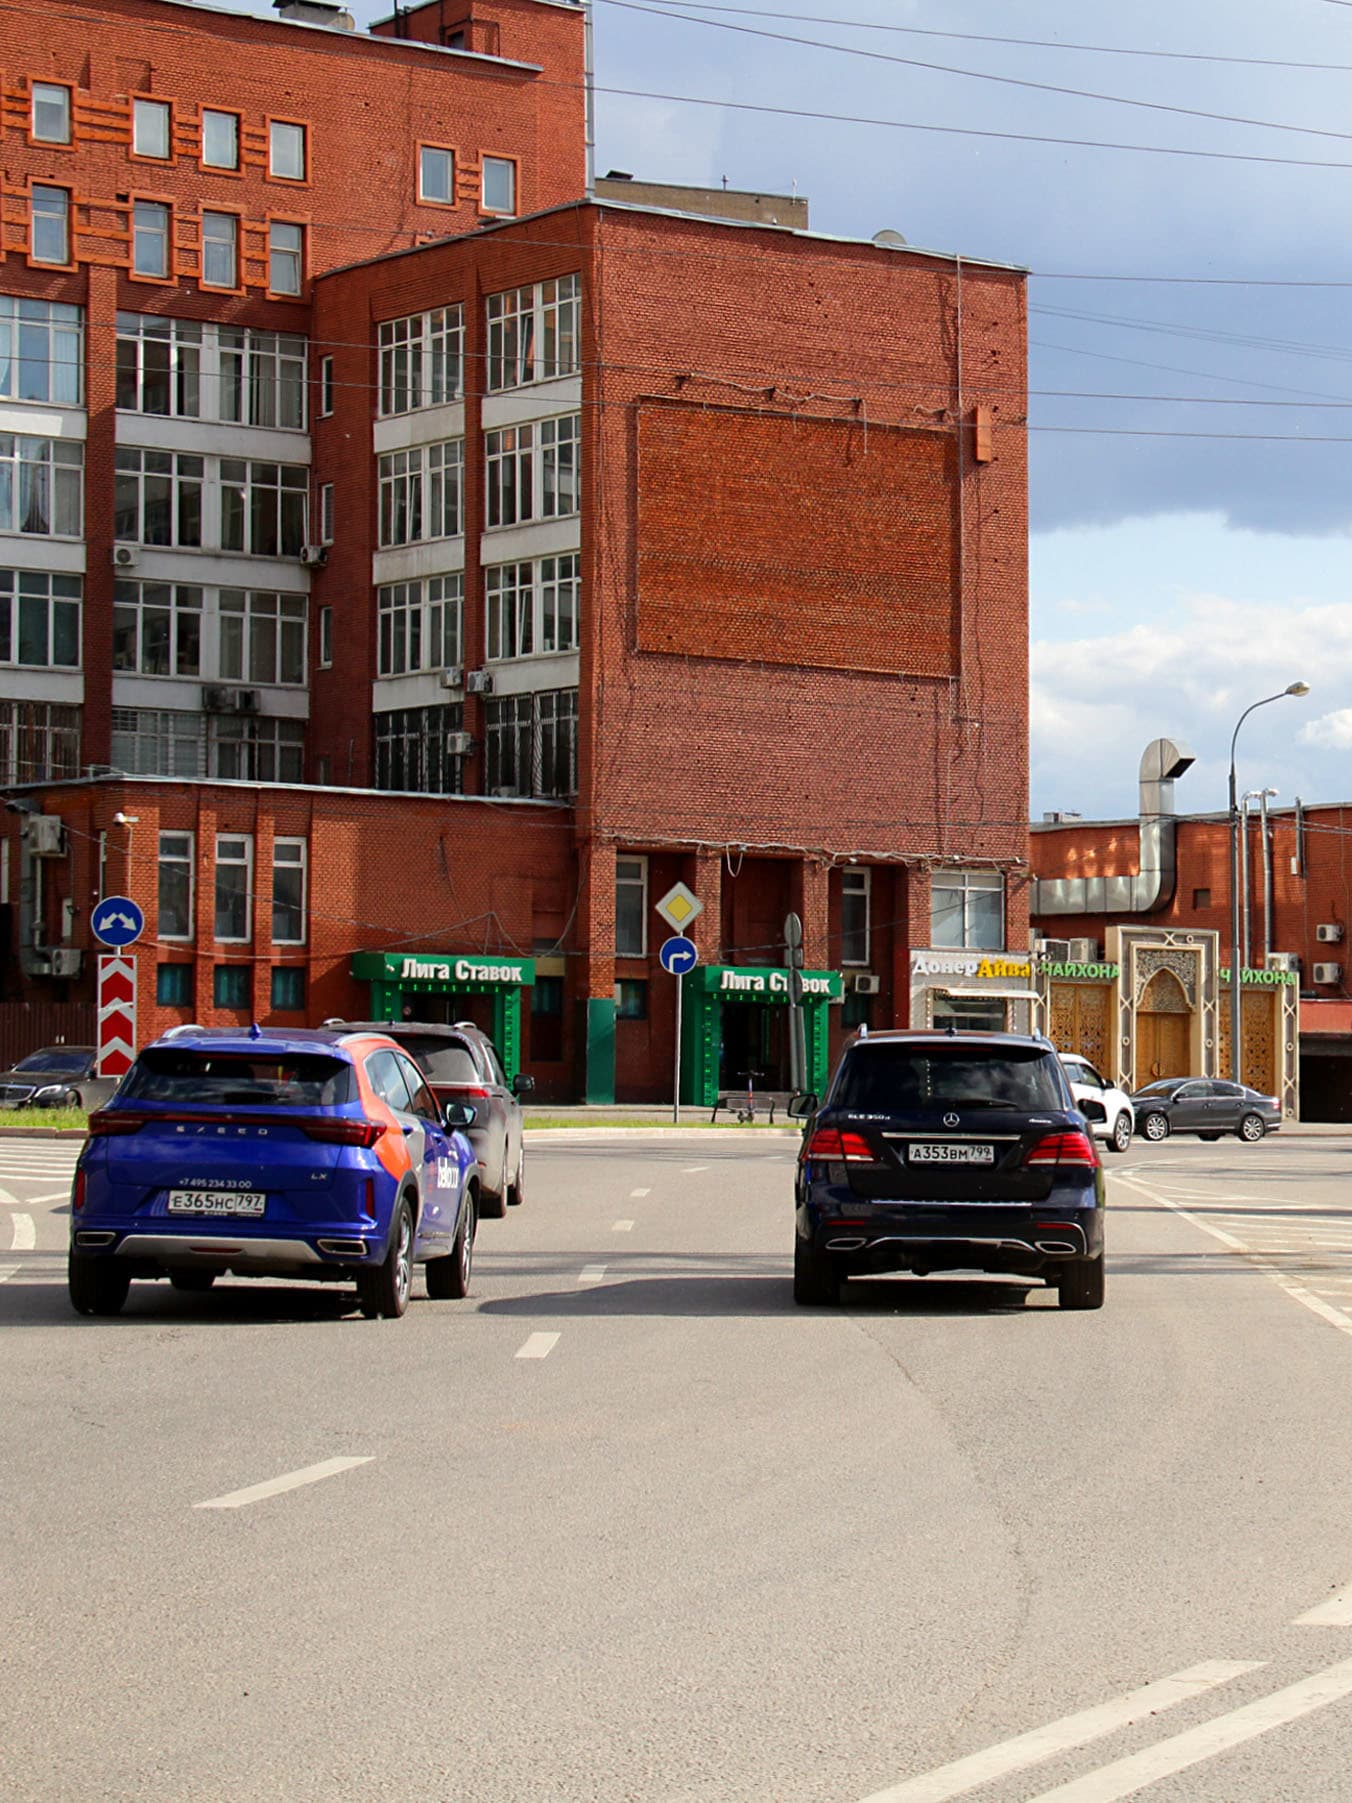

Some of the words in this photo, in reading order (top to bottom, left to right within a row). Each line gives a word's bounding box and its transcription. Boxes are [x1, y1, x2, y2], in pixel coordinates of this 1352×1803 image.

[401, 958, 450, 980] Лига
[455, 960, 522, 981] Ставок
[912, 957, 977, 977] Донер
[977, 958, 1030, 978] Айва
[1041, 962, 1120, 978] ЧАЙХОНА
[1219, 967, 1296, 985] ЧЙХОНА
[720, 970, 765, 991] Лига
[769, 972, 830, 993] Ствок
[970, 1145, 991, 1157] 799
[190, 1178, 207, 1187] 495
[208, 1179, 224, 1188] 234
[226, 1180, 237, 1188] 33
[239, 1180, 252, 1189] 00
[237, 1194, 261, 1208] 797
